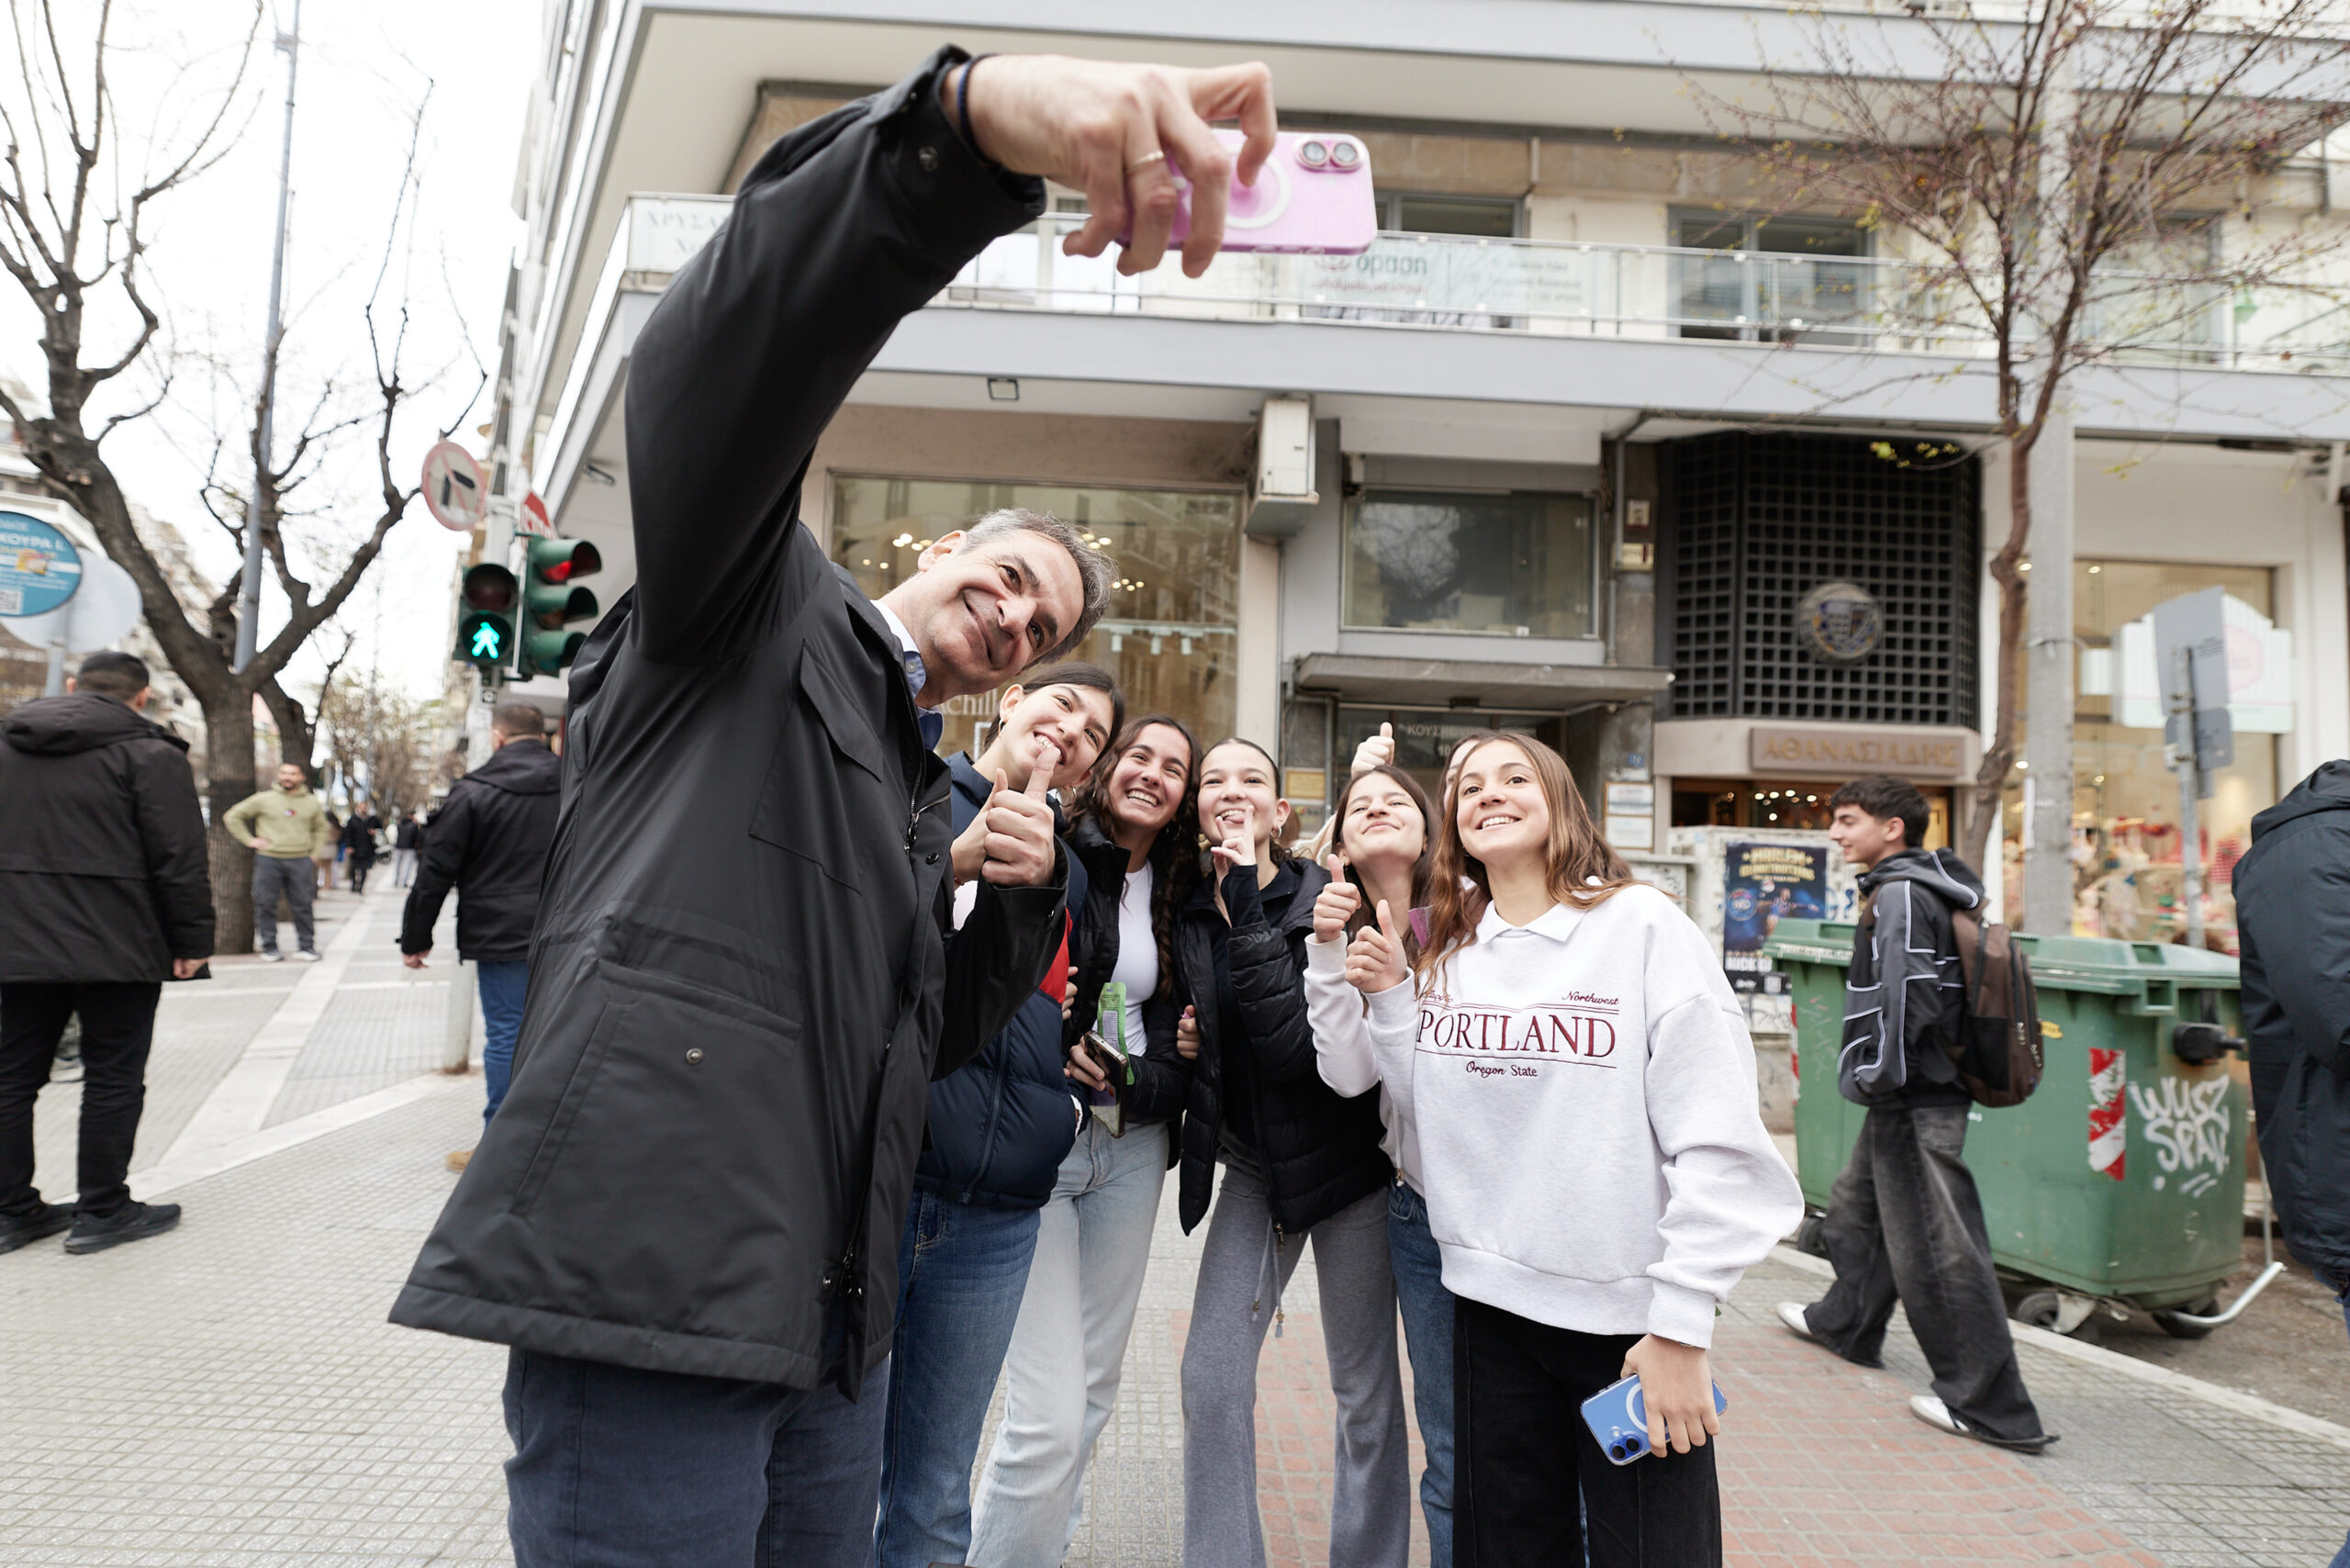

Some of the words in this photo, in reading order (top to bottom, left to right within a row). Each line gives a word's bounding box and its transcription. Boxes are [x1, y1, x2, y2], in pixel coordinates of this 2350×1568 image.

[1763, 738, 1959, 767] ΑΘΑΝΑΣΙΑΔΗΣ
[1562, 991, 1620, 1006] Northwest
[1416, 1009, 1616, 1058] PORTLAND
[1466, 1060, 1505, 1078] Oregon
[1511, 1065, 1538, 1077] State
